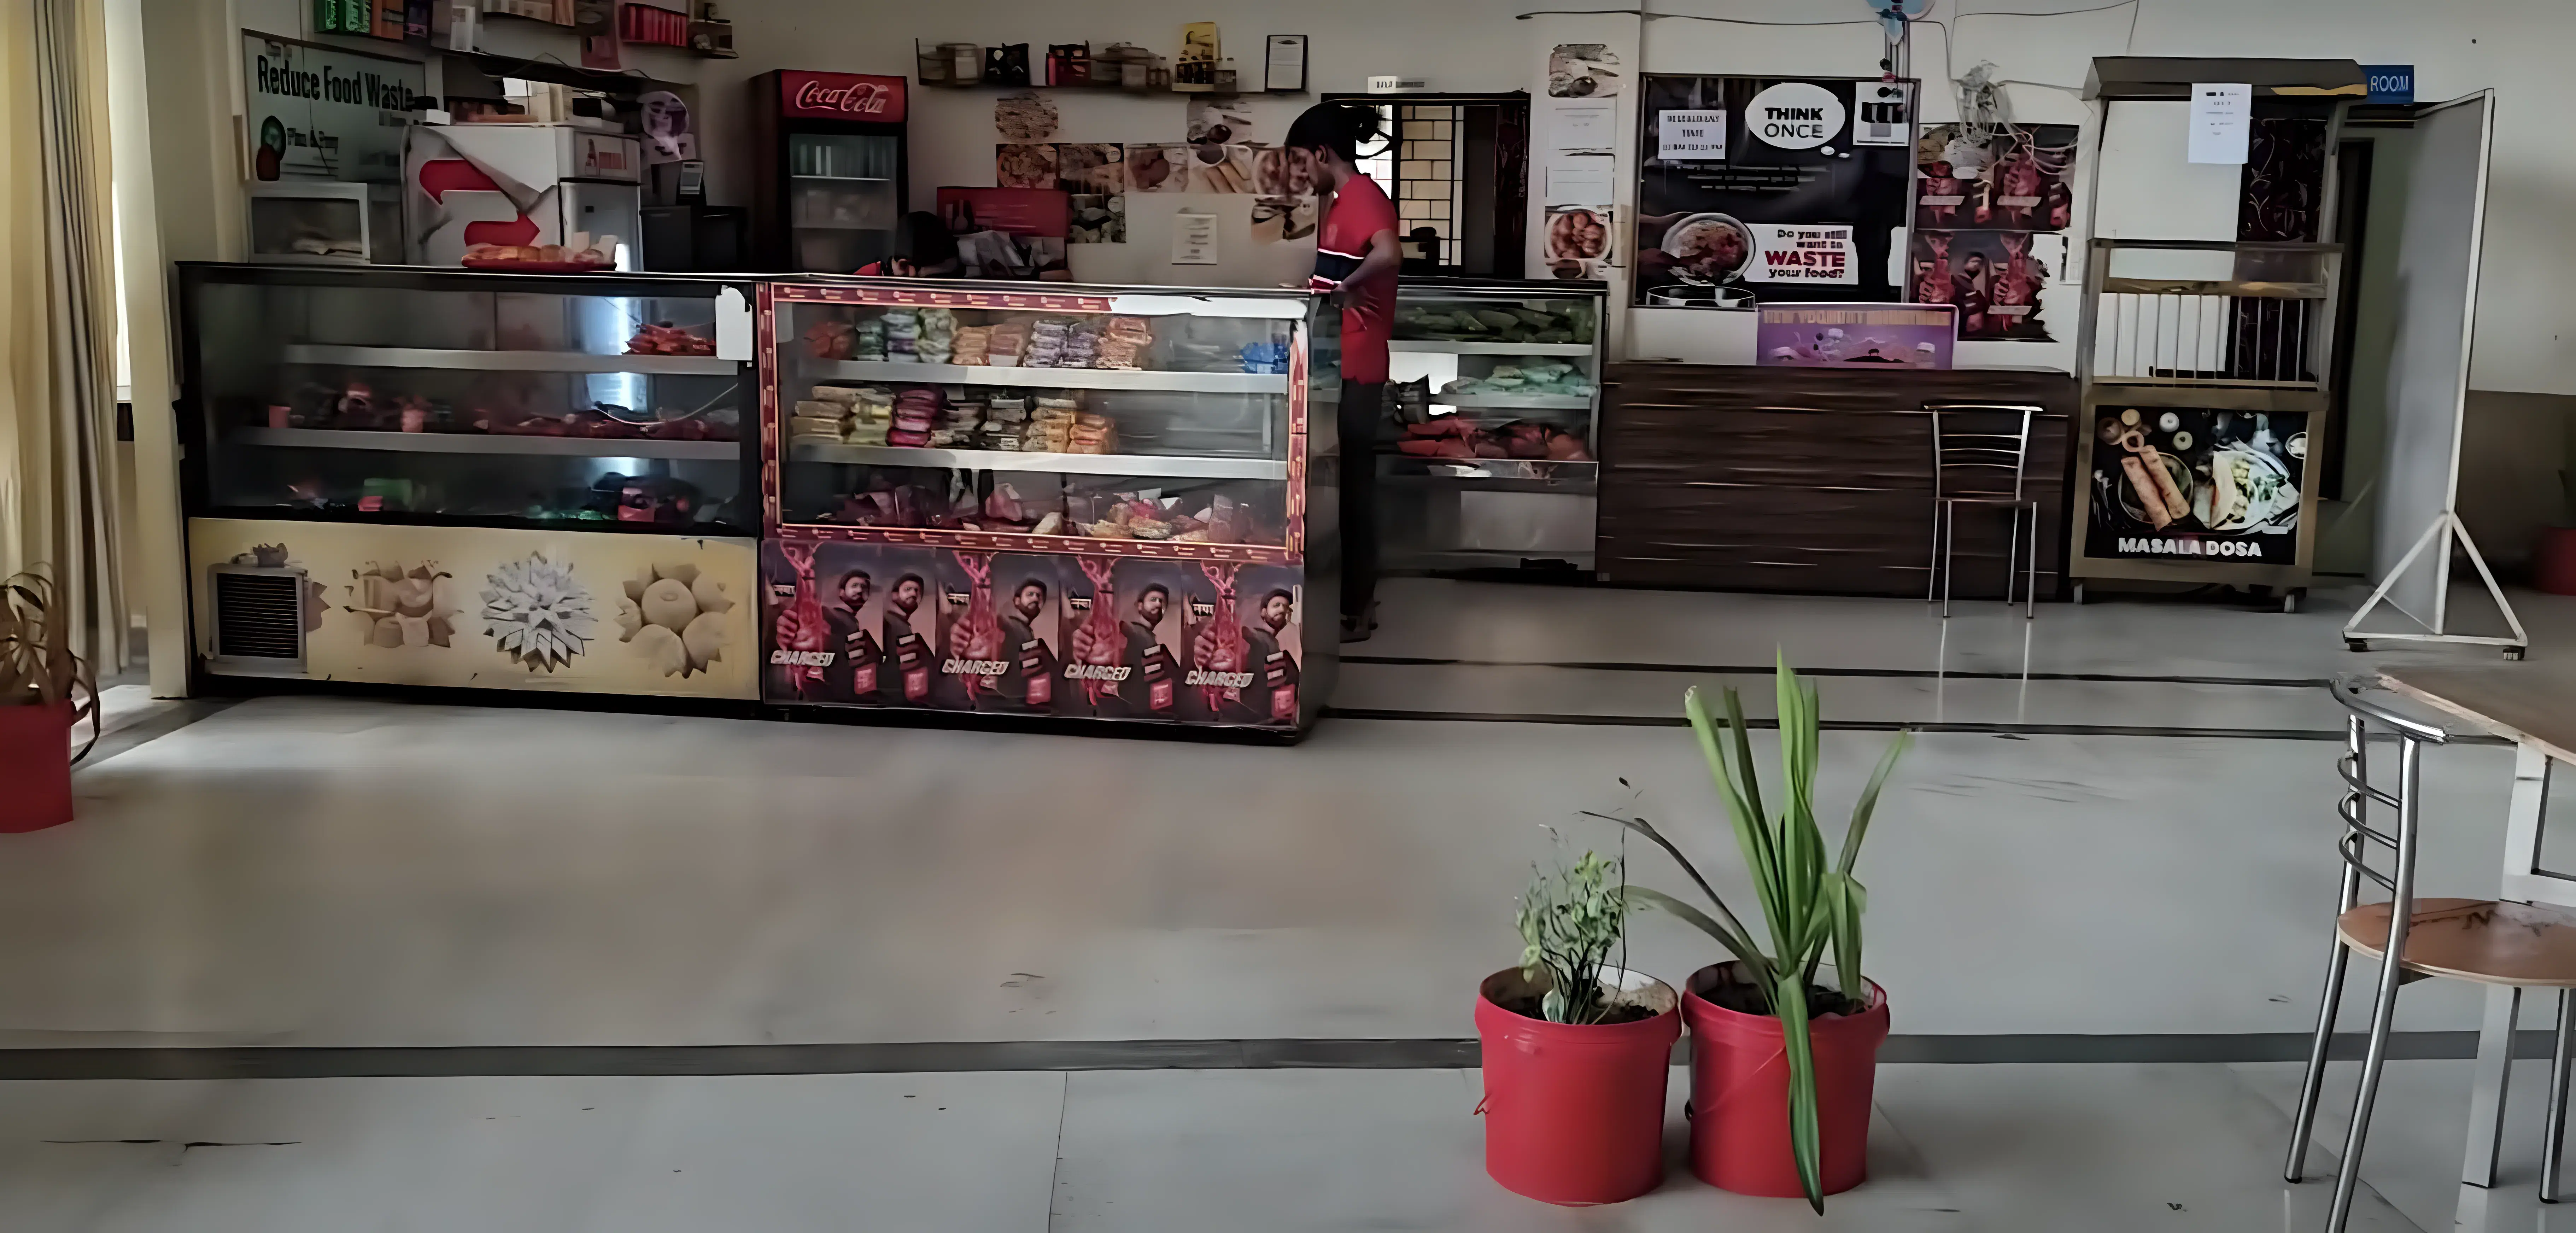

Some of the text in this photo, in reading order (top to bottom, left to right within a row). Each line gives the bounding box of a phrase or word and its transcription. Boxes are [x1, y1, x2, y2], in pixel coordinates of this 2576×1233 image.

[257, 54, 414, 112] Reduce Food Waste
[2370, 75, 2409, 93] ROOM
[1764, 107, 1823, 121] THINK
[1764, 123, 1823, 139] ONCE
[1777, 229, 1795, 238] Do
[1798, 231, 1821, 240] you
[1764, 250, 1845, 267] WASTE
[1768, 269, 1801, 278] your
[2118, 537, 2262, 557] MASALA DOSA
[942, 658, 1010, 675] CHARGED
